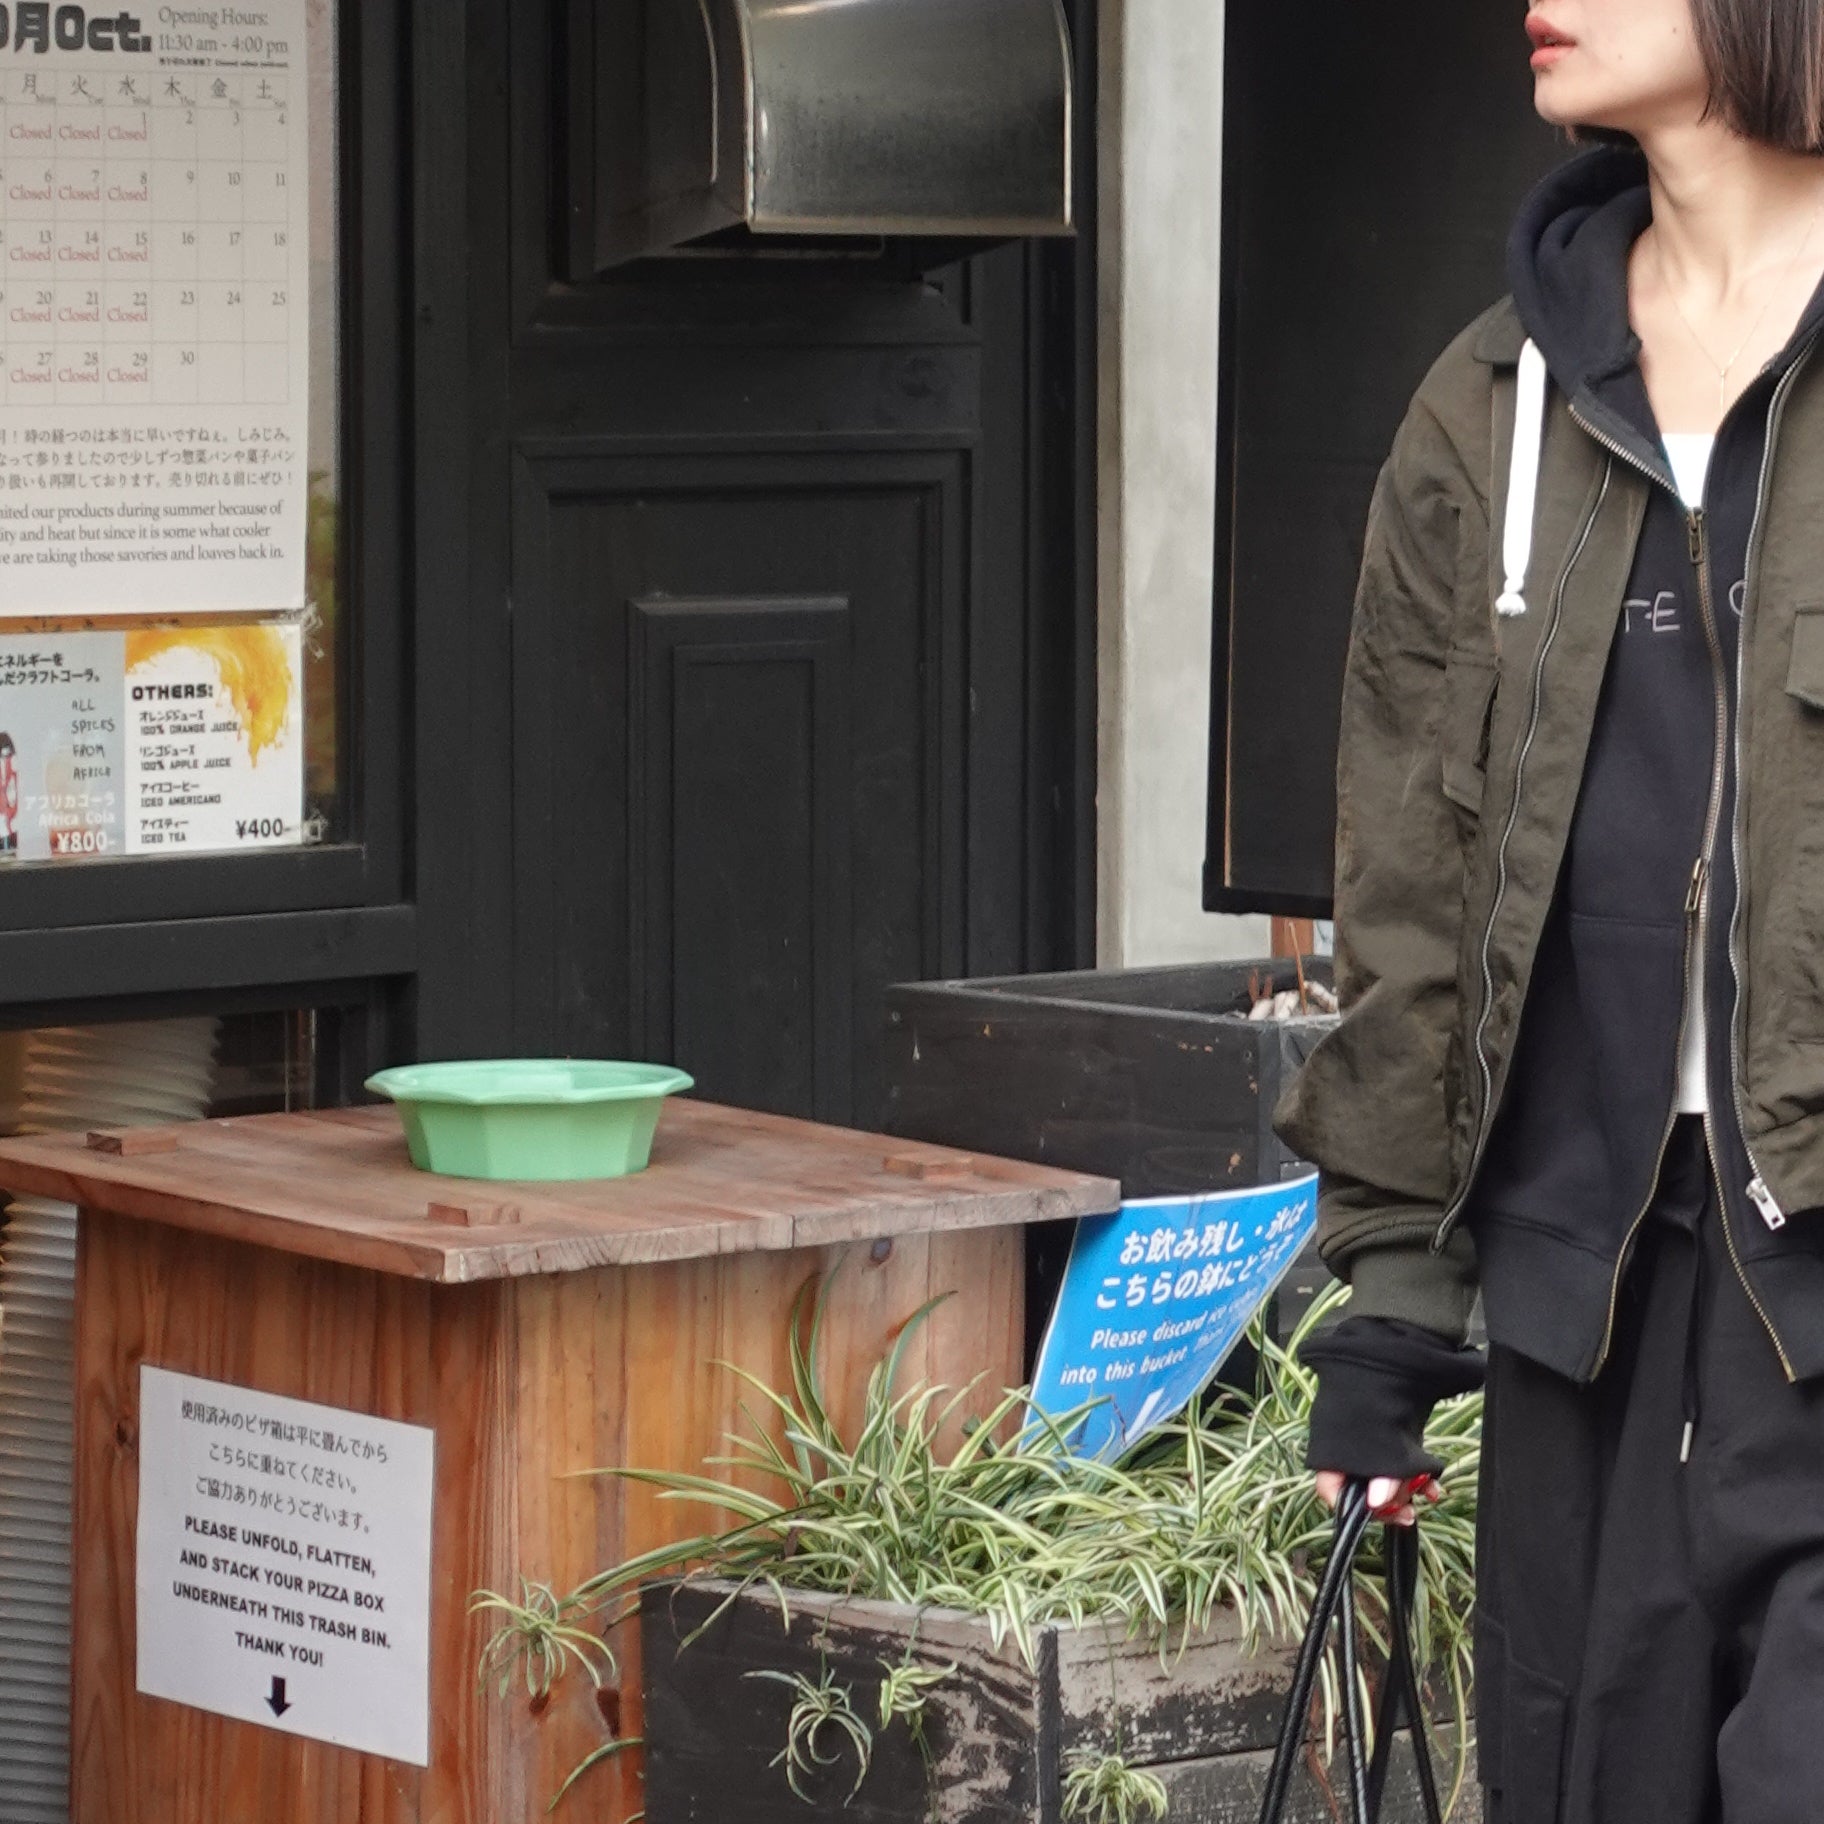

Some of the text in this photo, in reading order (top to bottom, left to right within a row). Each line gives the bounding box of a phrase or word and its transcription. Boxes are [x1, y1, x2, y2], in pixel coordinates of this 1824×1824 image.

[158, 6, 269, 30] Opening Hours:
[159, 34, 193, 51] 11:30
[196, 38, 218, 51] am
[231, 35, 263, 53] 4:00
[265, 40, 288, 58] pm
[70, 75, 89, 95] 火
[164, 76, 181, 96] 木
[211, 77, 228, 98] 金
[10, 123, 147, 141] Closed Closed Closed
[10, 184, 148, 202] Closed Closed Closed
[39, 230, 287, 246] 13 14 15 16 17 18
[10, 246, 148, 263] Closed Closed Closed
[36, 291, 287, 306] 20 21 22 23 24 25
[10, 306, 149, 323] Closed Closed Closed
[37, 352, 53, 366] 27
[132, 352, 149, 367] 29
[181, 351, 195, 365] 30
[10, 368, 148, 383] Closed Closed Closed
[31, 507, 55, 519] our
[57, 502, 114, 524] products
[117, 502, 160, 522] during
[162, 506, 216, 517] summer
[218, 500, 267, 516] because
[269, 499, 284, 516] of
[20, 525, 44, 541] and
[47, 524, 76, 540] heat
[78, 524, 101, 539] but
[103, 524, 136, 539] since
[138, 524, 148, 539] it
[150, 524, 160, 539] is
[162, 527, 197, 539] some
[199, 521, 230, 537] what
[232, 521, 271, 537] cooler
[13, 552, 35, 564] are
[36, 547, 77, 568] taking
[79, 546, 115, 563] those
[117, 546, 168, 562] savories
[170, 544, 195, 561] and
[197, 543, 236, 560] loaves
[238, 542, 267, 559] back
[269, 542, 285, 559] in.
[131, 684, 214, 701] OTHERS:
[71, 698, 96, 712] ALL
[140, 721, 238, 735] 100% ORANGE JUICE
[72, 744, 106, 759] FROM
[141, 757, 232, 771] 100% APPLE JUICE
[140, 781, 201, 794] アイスコーヒー
[168, 793, 222, 806] AMERICANO
[169, 832, 186, 843] TEA
[1090, 1328, 1149, 1350] Please
[1152, 1309, 1209, 1342] discard
[1059, 1363, 1098, 1386] into
[1104, 1359, 1136, 1382] this
[208, 1442, 357, 1495] こちらに重ねてください。
[195, 1476, 371, 1534] ご協力ありがとうございます。
[185, 1515, 376, 1578] PLEASE UNFOLD, FLATTEN,
[179, 1549, 385, 1613] AND STACK YOUR PIZZA BOX
[172, 1580, 392, 1650] UNDERNEATH THIS TRASH BIN.
[234, 1631, 324, 1668] THANK YOU!
